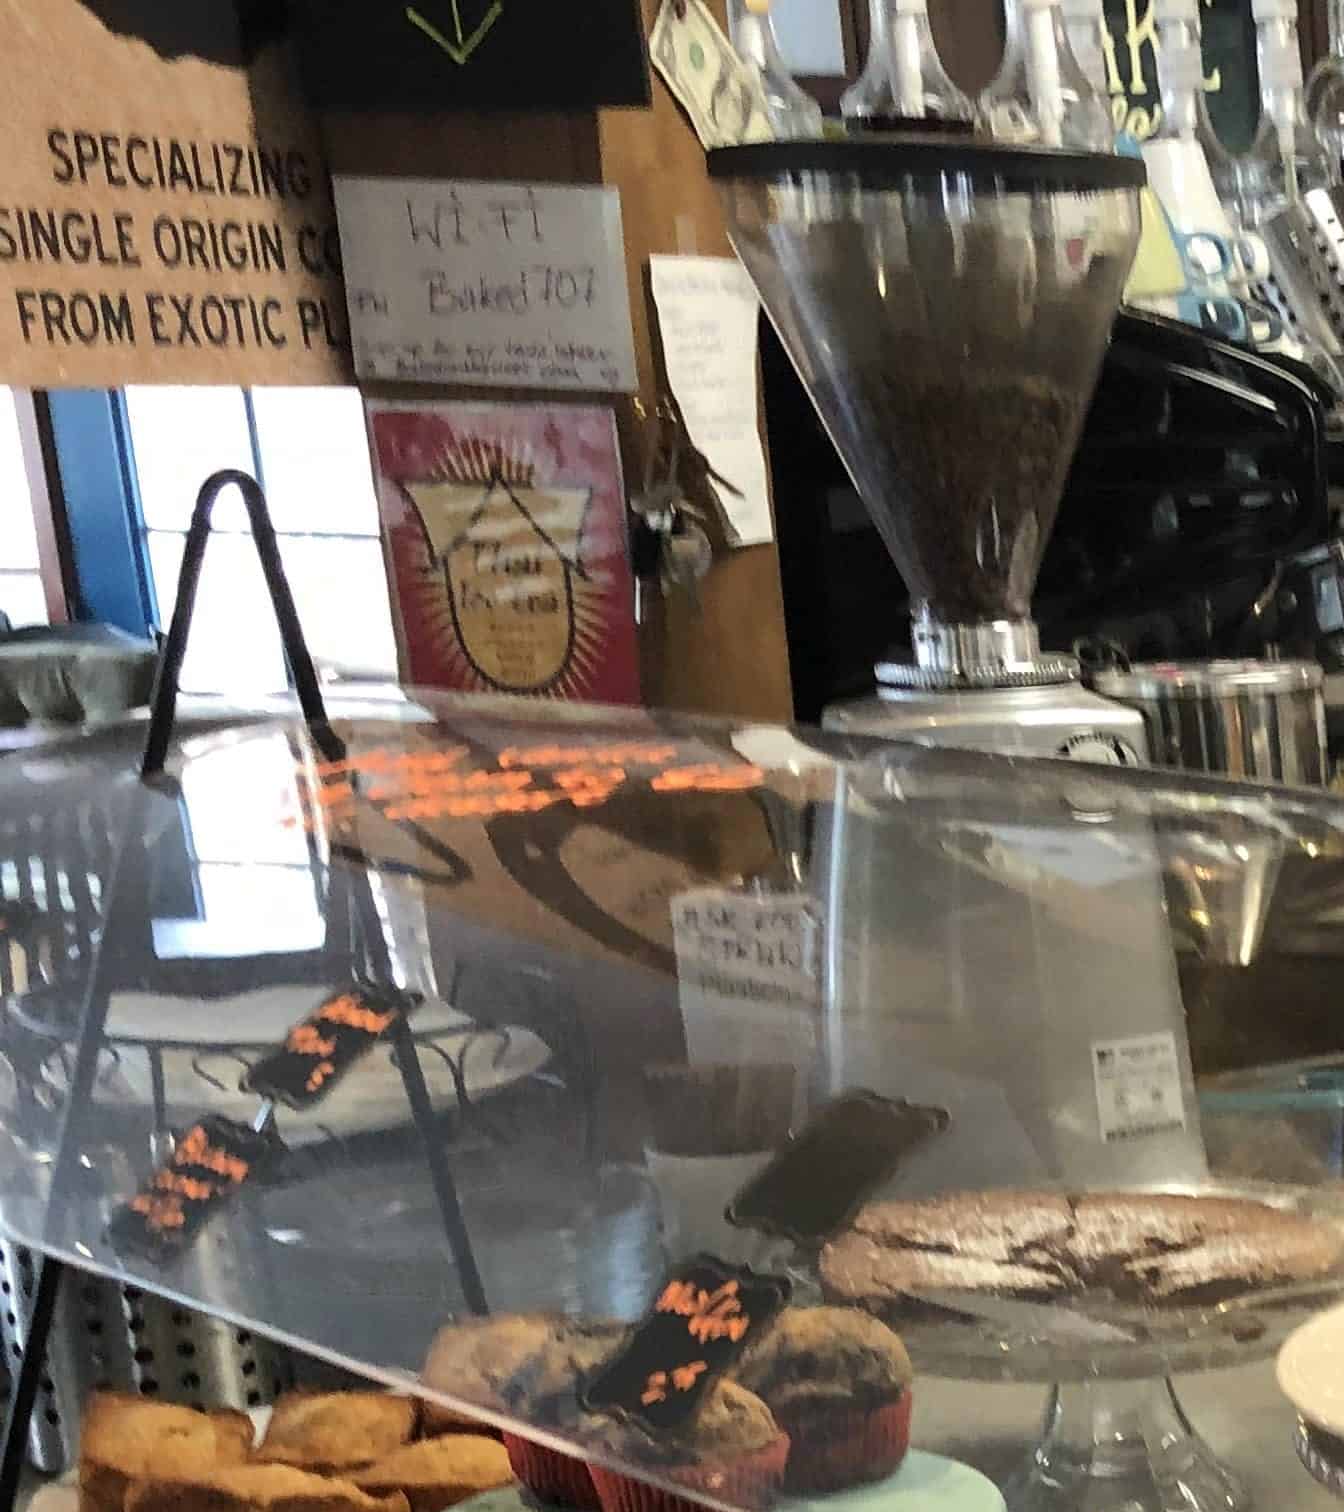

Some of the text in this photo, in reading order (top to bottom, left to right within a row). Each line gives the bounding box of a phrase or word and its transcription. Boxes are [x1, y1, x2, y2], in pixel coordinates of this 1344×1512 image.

[47, 127, 312, 202] SPECIALIZING
[0, 207, 142, 267] SINGLE
[153, 213, 287, 275] ORIGIN
[14, 287, 137, 346] FROM
[146, 290, 287, 349] EXOTIC
